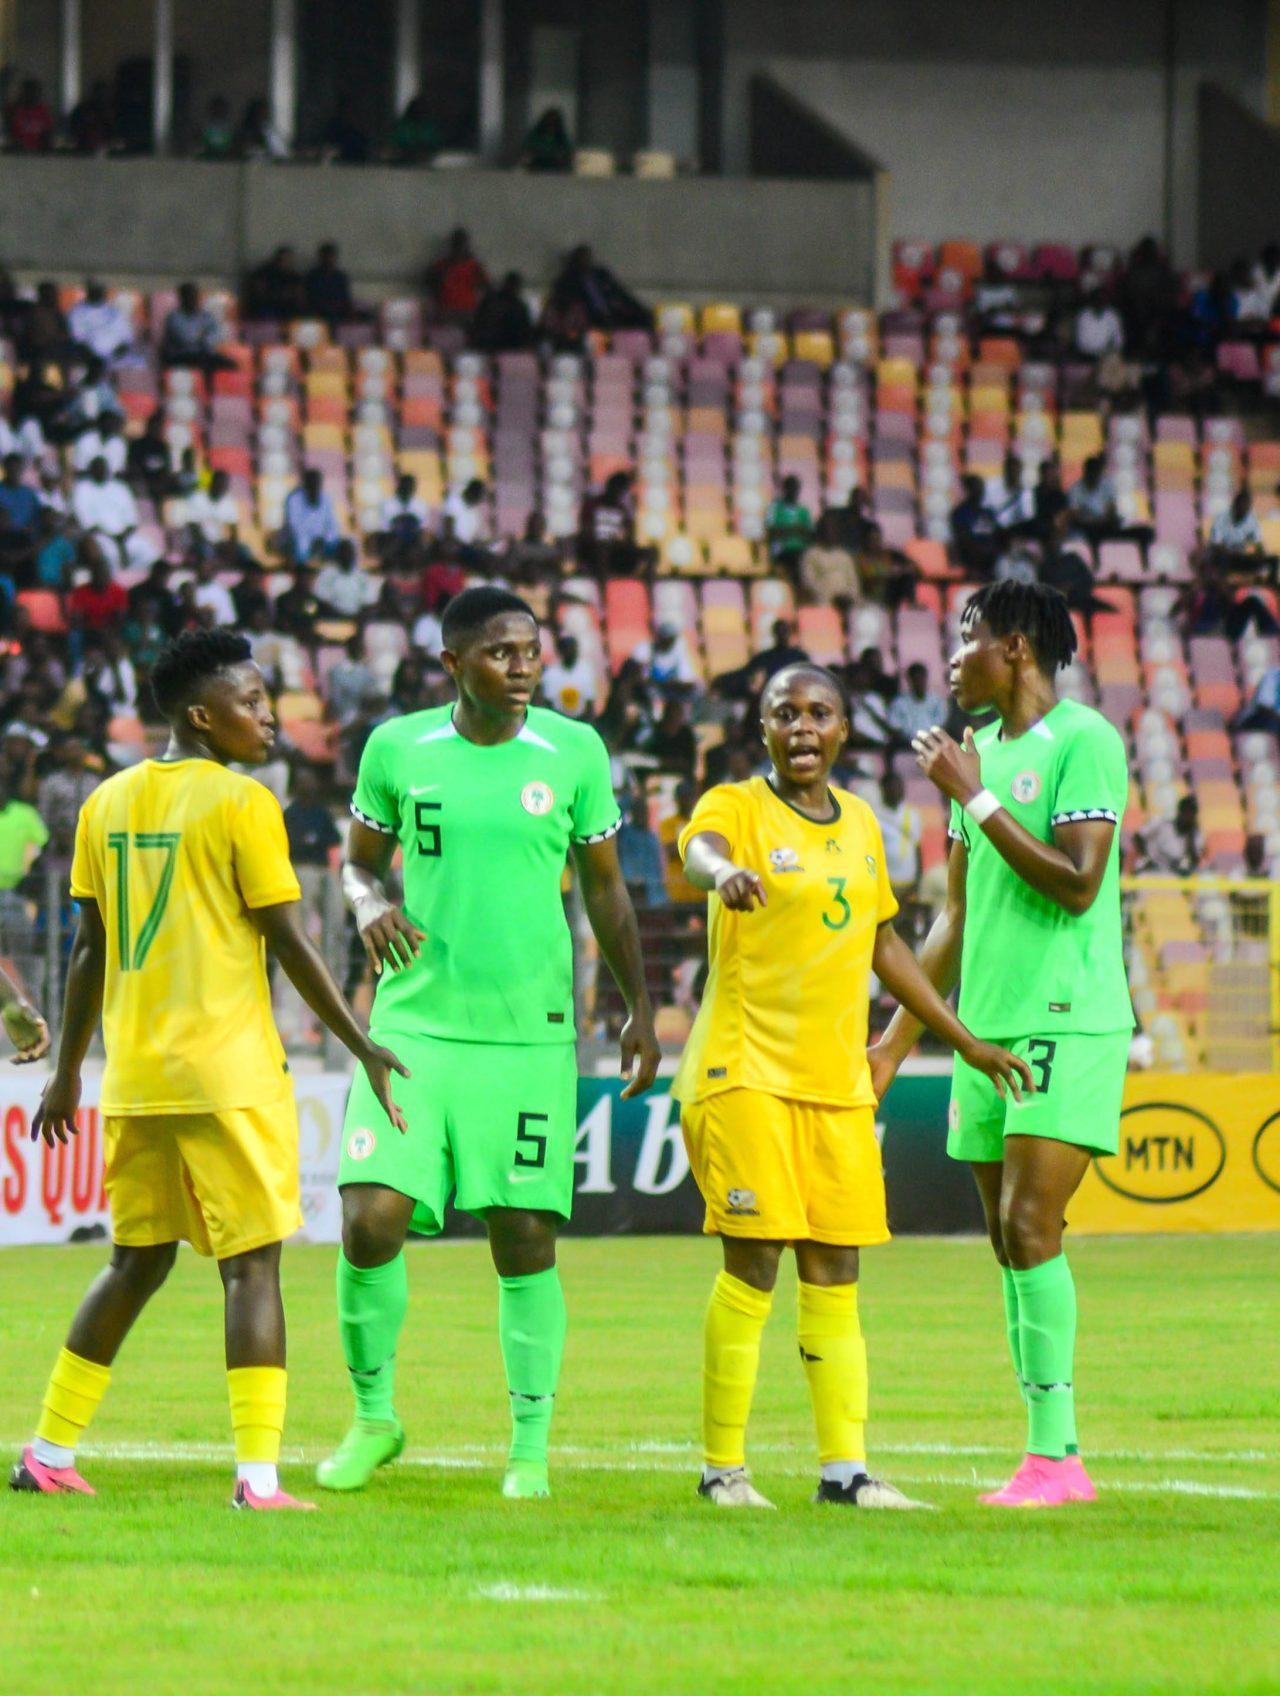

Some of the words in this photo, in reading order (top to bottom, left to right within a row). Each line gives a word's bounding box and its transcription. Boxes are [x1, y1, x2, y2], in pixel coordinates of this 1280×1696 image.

[415, 802, 442, 857] 5
[107, 832, 182, 972] 17
[821, 877, 851, 931] 3
[1021, 1038, 1057, 1095] 3
[514, 1111, 549, 1168] 5
[1125, 1135, 1195, 1172] MTN
